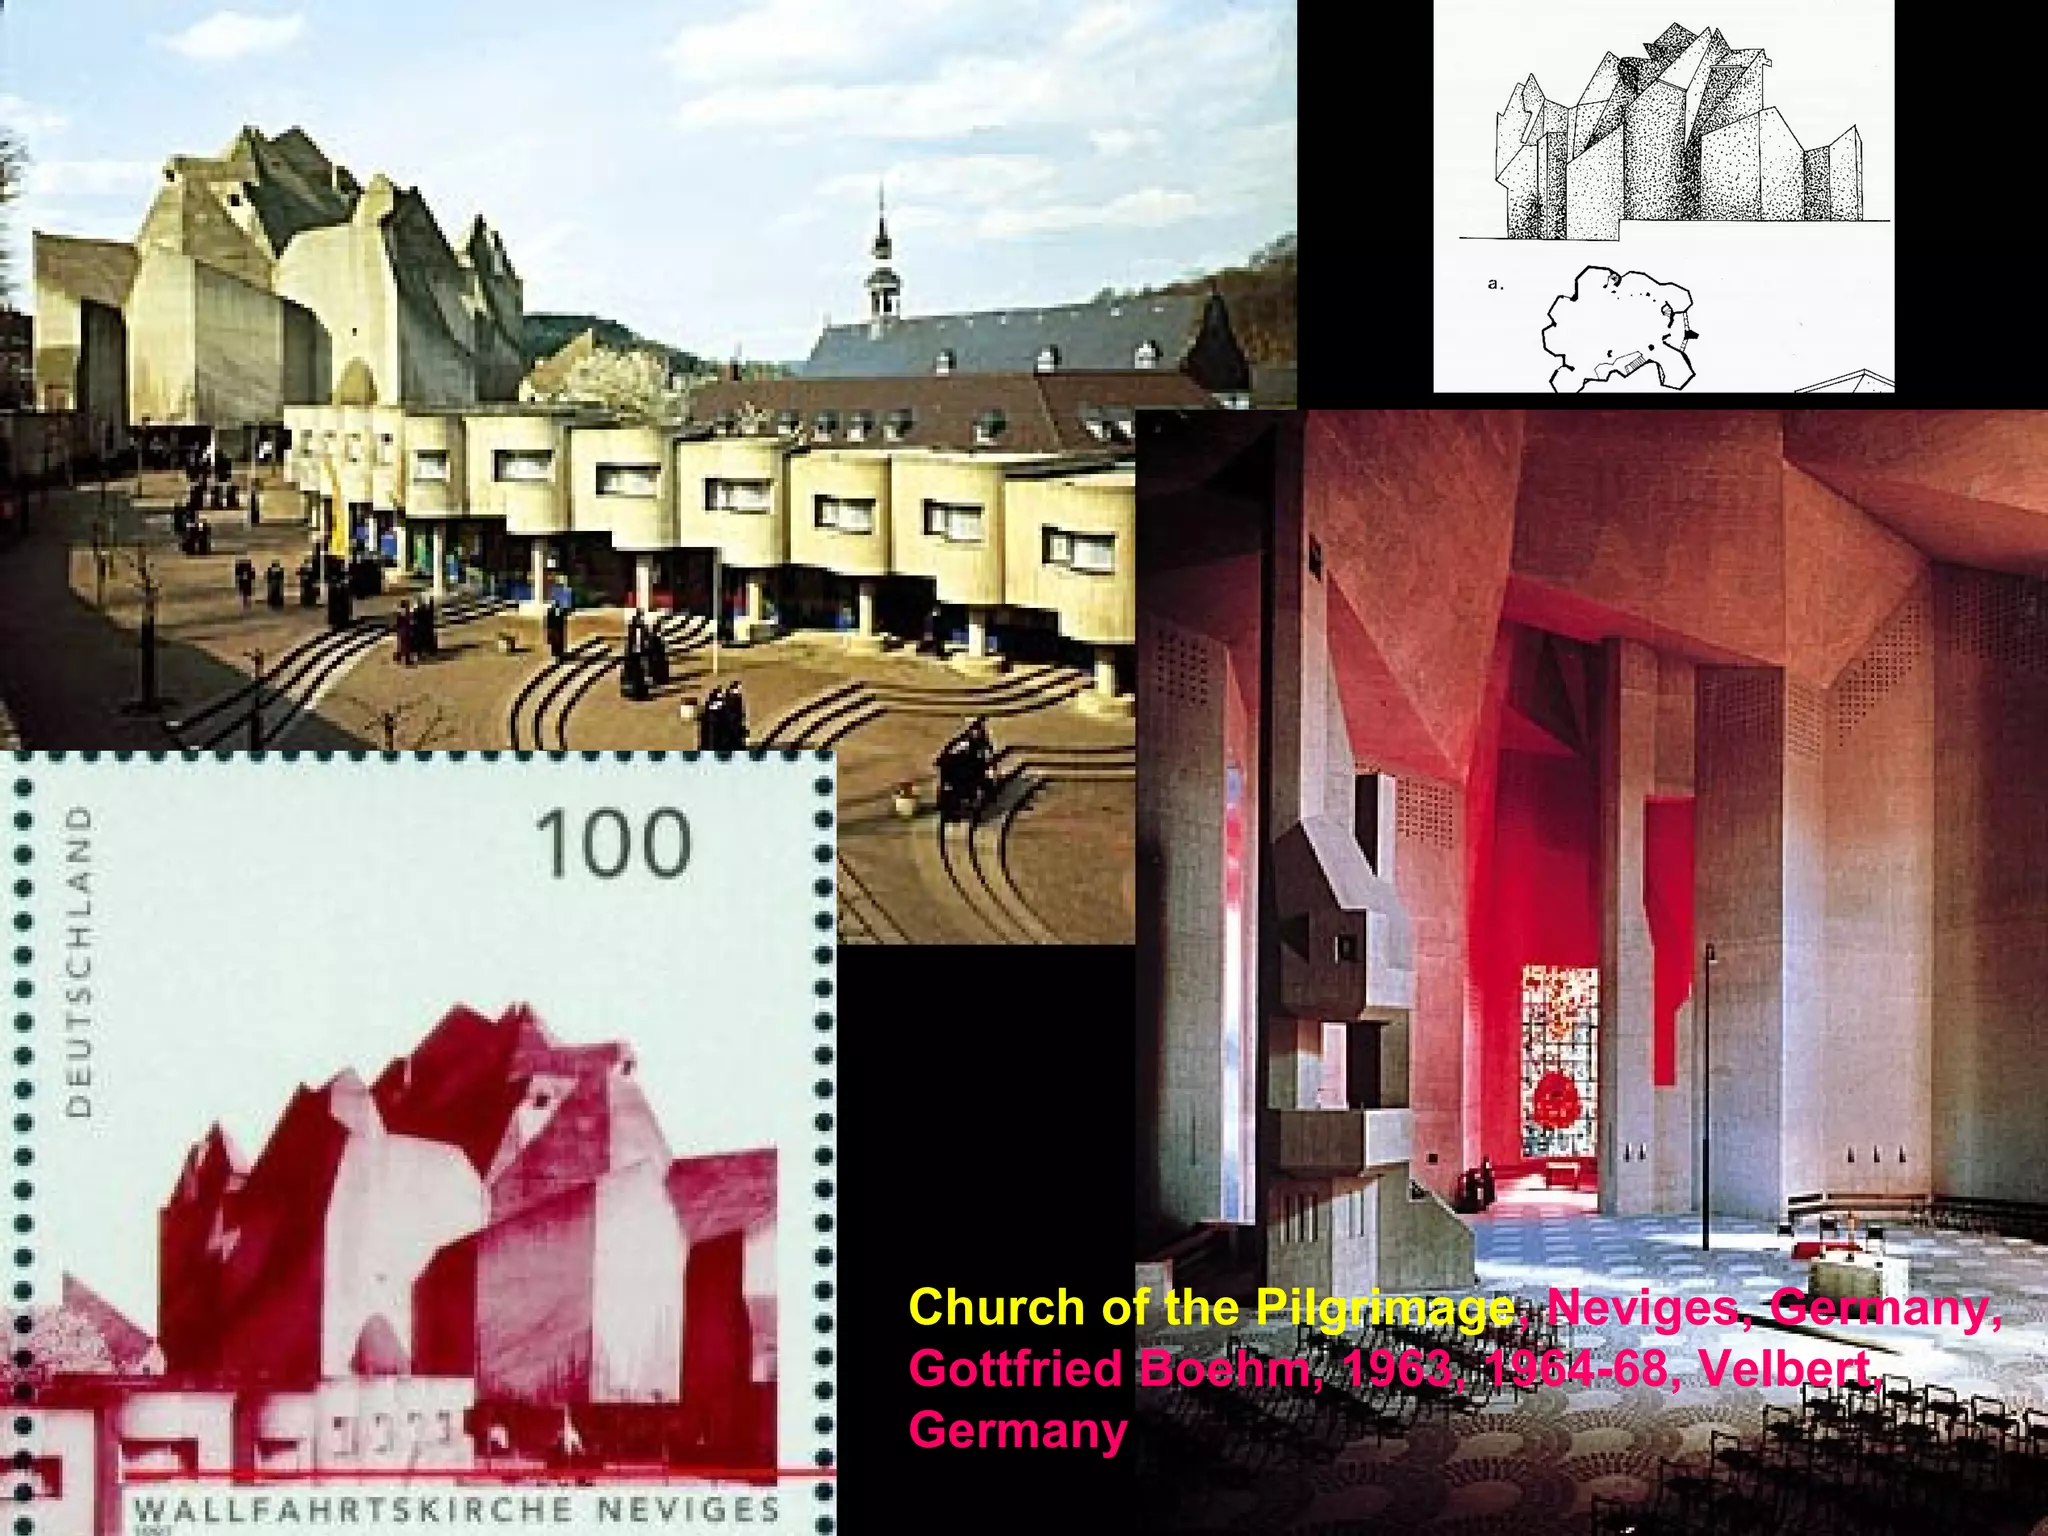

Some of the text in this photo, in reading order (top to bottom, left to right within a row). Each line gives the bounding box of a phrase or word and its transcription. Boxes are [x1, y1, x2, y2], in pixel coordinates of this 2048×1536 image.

[1488, 279, 1504, 290] a.
[537, 806, 690, 879] 100
[66, 806, 92, 1118] DEUTSCHLAND
[135, 1496, 778, 1523] WALLFAHRTSKIRCHE NEVIGES
